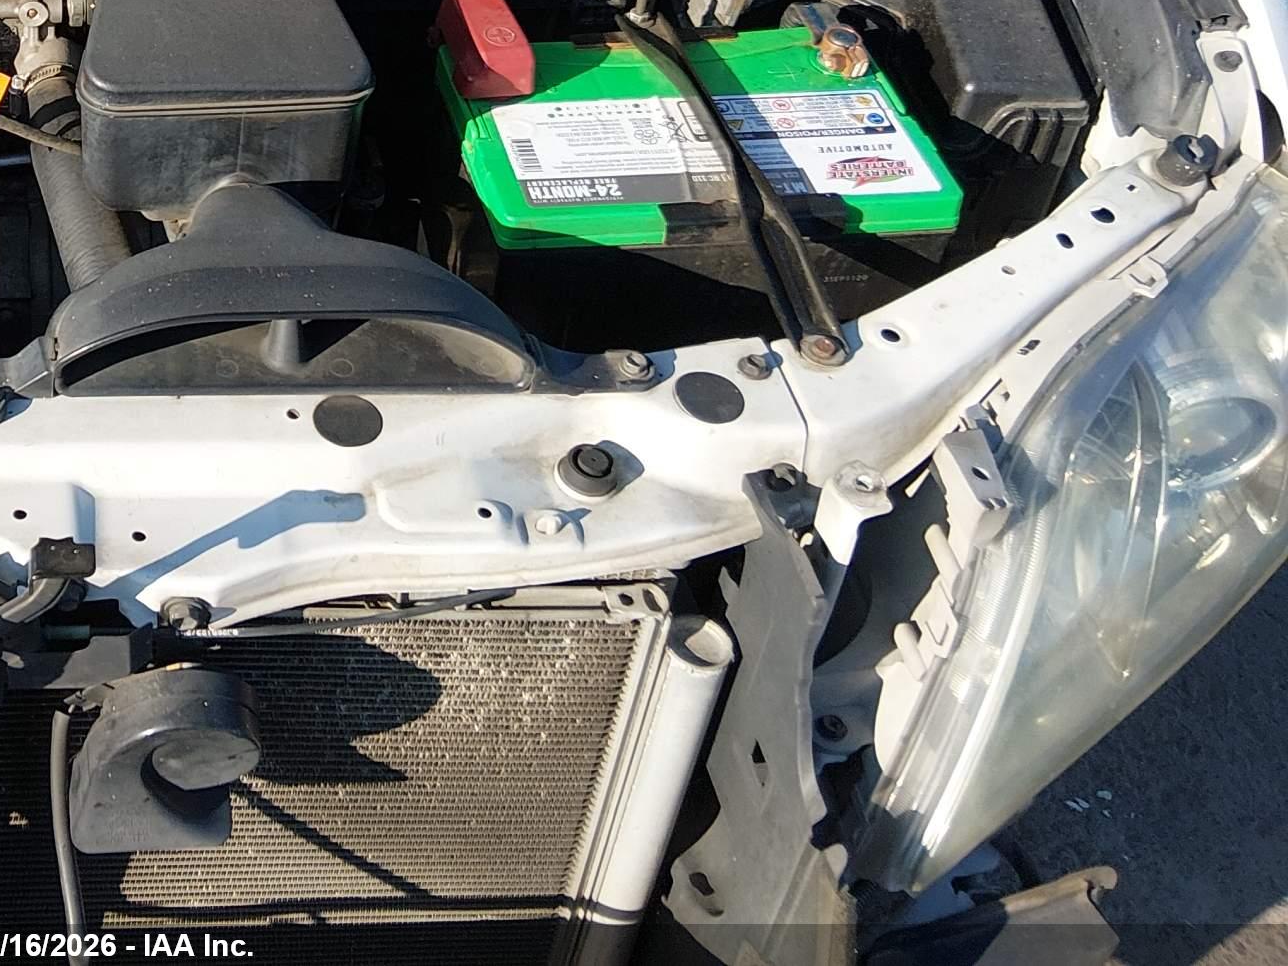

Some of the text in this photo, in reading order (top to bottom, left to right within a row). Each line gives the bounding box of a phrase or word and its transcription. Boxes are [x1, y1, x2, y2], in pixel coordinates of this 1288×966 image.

[817, 143, 892, 154] AUTOMOTIVE
[829, 160, 906, 171] BATTERIES
[826, 167, 914, 180] INTERSTATE
[527, 184, 623, 200] 24-MONTH
